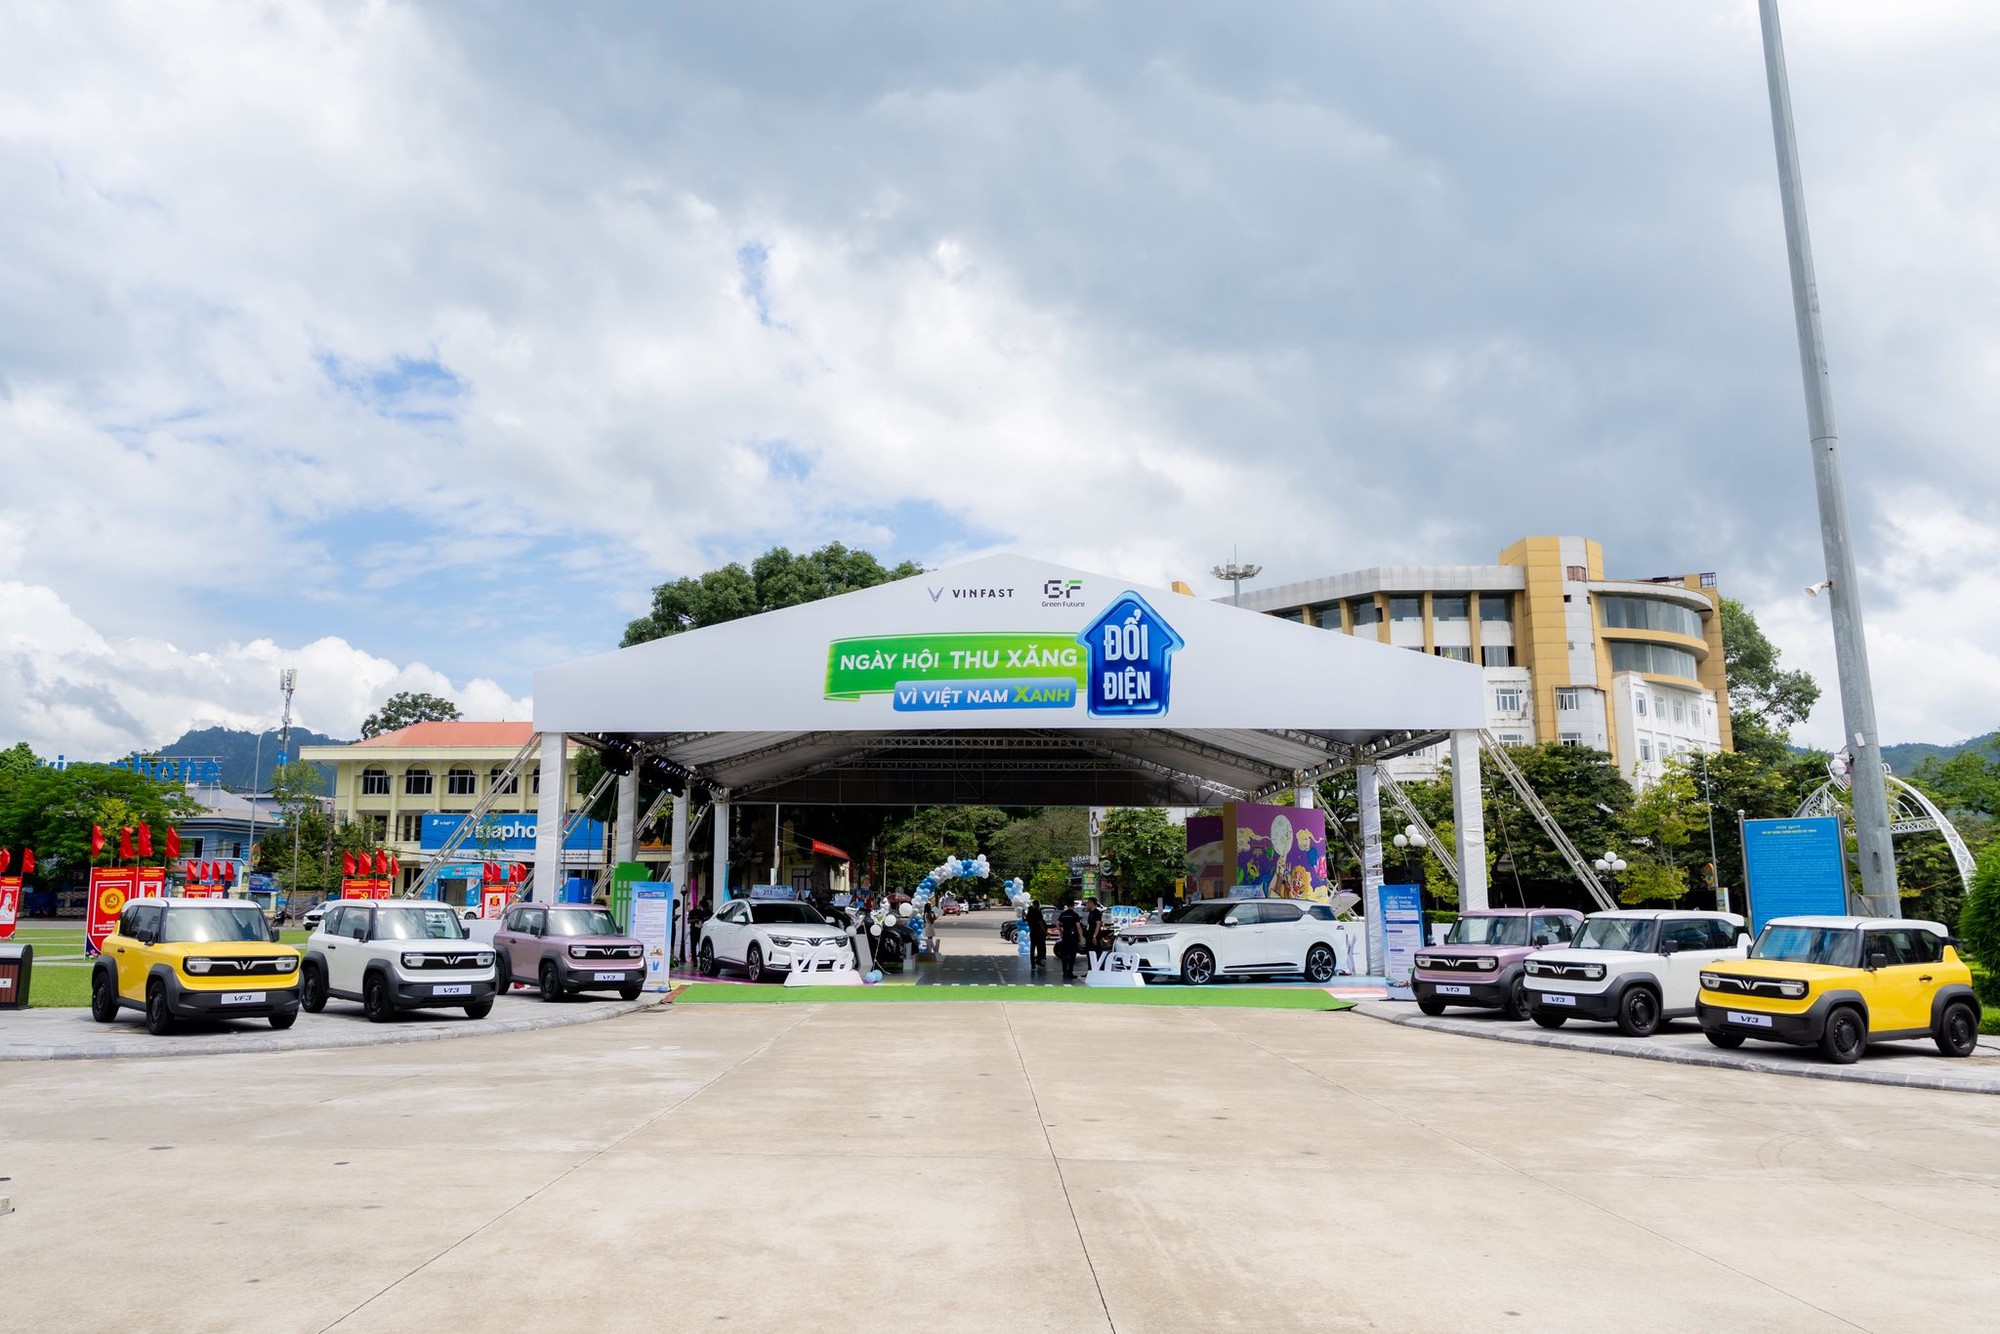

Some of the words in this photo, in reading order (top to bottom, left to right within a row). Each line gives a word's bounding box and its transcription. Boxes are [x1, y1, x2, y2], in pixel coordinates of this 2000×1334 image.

[952, 588, 1015, 598] VINFAST
[1103, 608, 1149, 661] ĐỔI
[840, 649, 898, 671] NGÀY
[902, 648, 940, 673] HỘI
[949, 650, 1000, 669] THU
[1005, 644, 1077, 668] XĂNG
[899, 687, 917, 704] VÌ
[922, 686, 962, 707] VIỆT
[966, 689, 1009, 703] NAM
[1103, 665, 1151, 705] ĐIỆN
